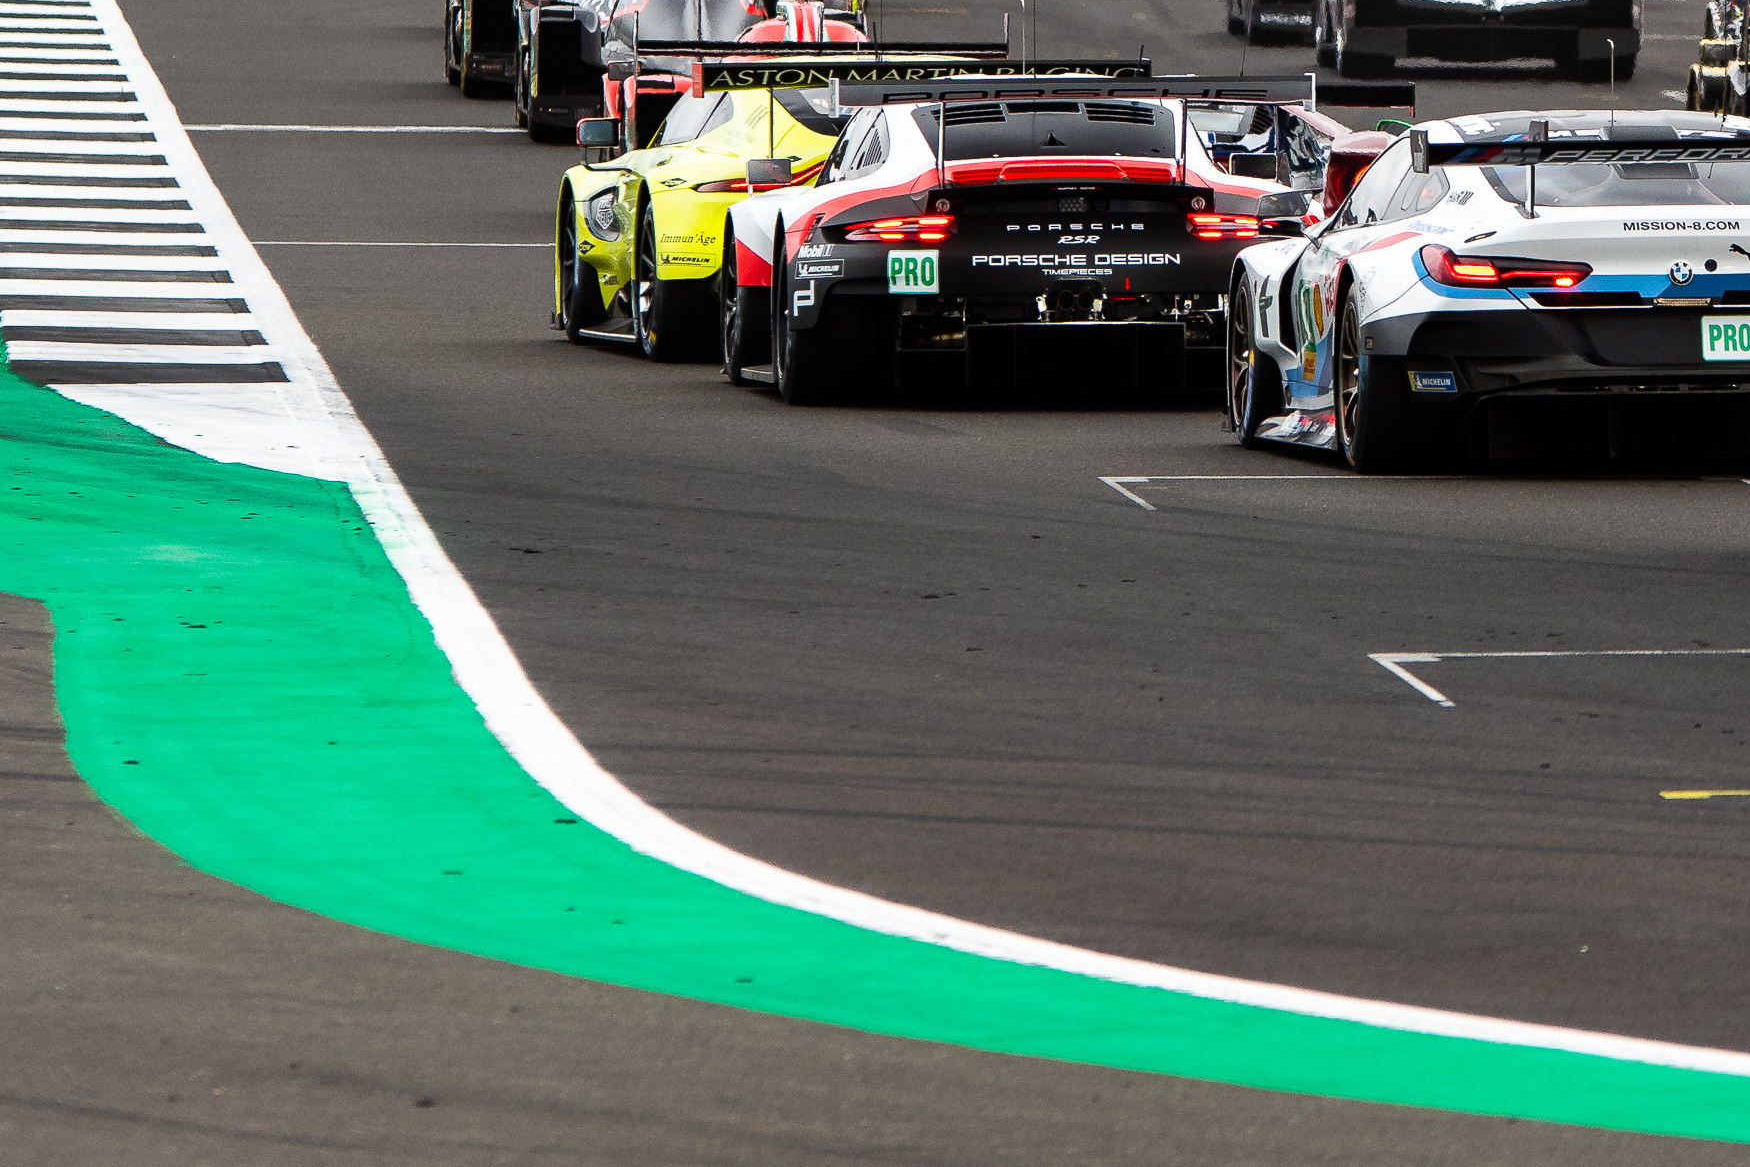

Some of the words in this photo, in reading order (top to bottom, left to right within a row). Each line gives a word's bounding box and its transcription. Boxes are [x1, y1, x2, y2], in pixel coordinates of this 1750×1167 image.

[710, 68, 834, 86] ASTON
[882, 87, 1268, 103] PORSCHE
[1006, 223, 1145, 232] PORSCHE
[1623, 221, 1740, 232] MISSION-8.COM
[1057, 235, 1101, 245] RSR
[798, 245, 823, 259] Mobil
[671, 255, 711, 263] MICHELIN
[972, 254, 1087, 266] PORSCHE
[1094, 253, 1181, 266] DESIGN
[808, 264, 840, 273] MICHELIN
[890, 256, 935, 287] PRO
[1042, 268, 1113, 276] TIMEPIECES
[1422, 377, 1451, 386] MICHELIN
